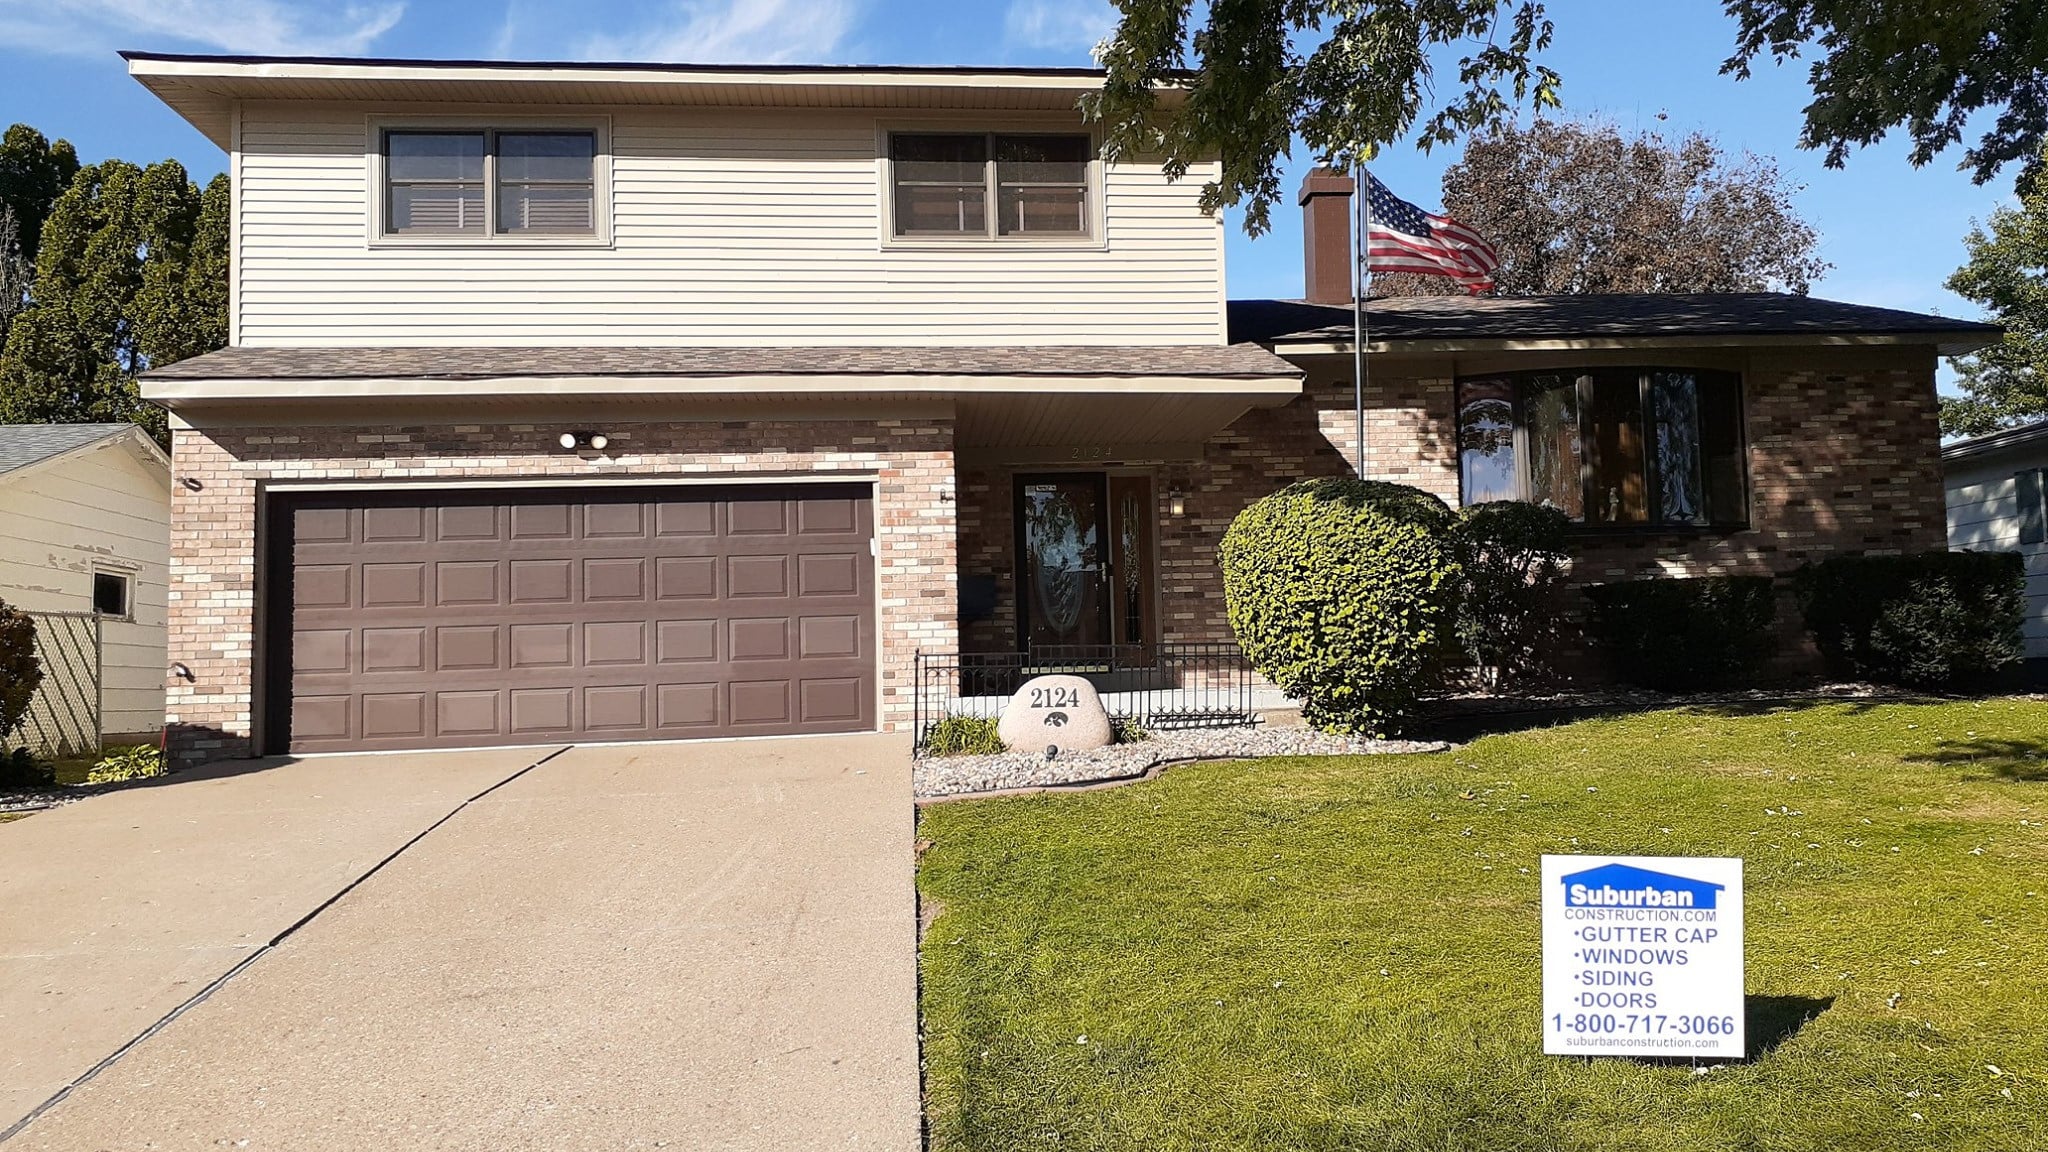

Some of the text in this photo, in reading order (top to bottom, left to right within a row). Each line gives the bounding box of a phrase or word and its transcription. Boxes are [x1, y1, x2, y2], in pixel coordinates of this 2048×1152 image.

[1071, 447, 1112, 459] 2124
[1030, 687, 1080, 708] 2124
[1570, 884, 1693, 906] Suburban
[1564, 908, 1716, 922] CONSTRUCTION.COM
[1581, 926, 1718, 943] GUTTER CAP
[1581, 948, 1688, 965] WINDOWS
[1581, 970, 1653, 986] SIDING
[1581, 992, 1657, 1008] DOORS
[1552, 1013, 1734, 1035] 1-800-717-3066
[1566, 1036, 1719, 1048] suburbanconstruction.com
